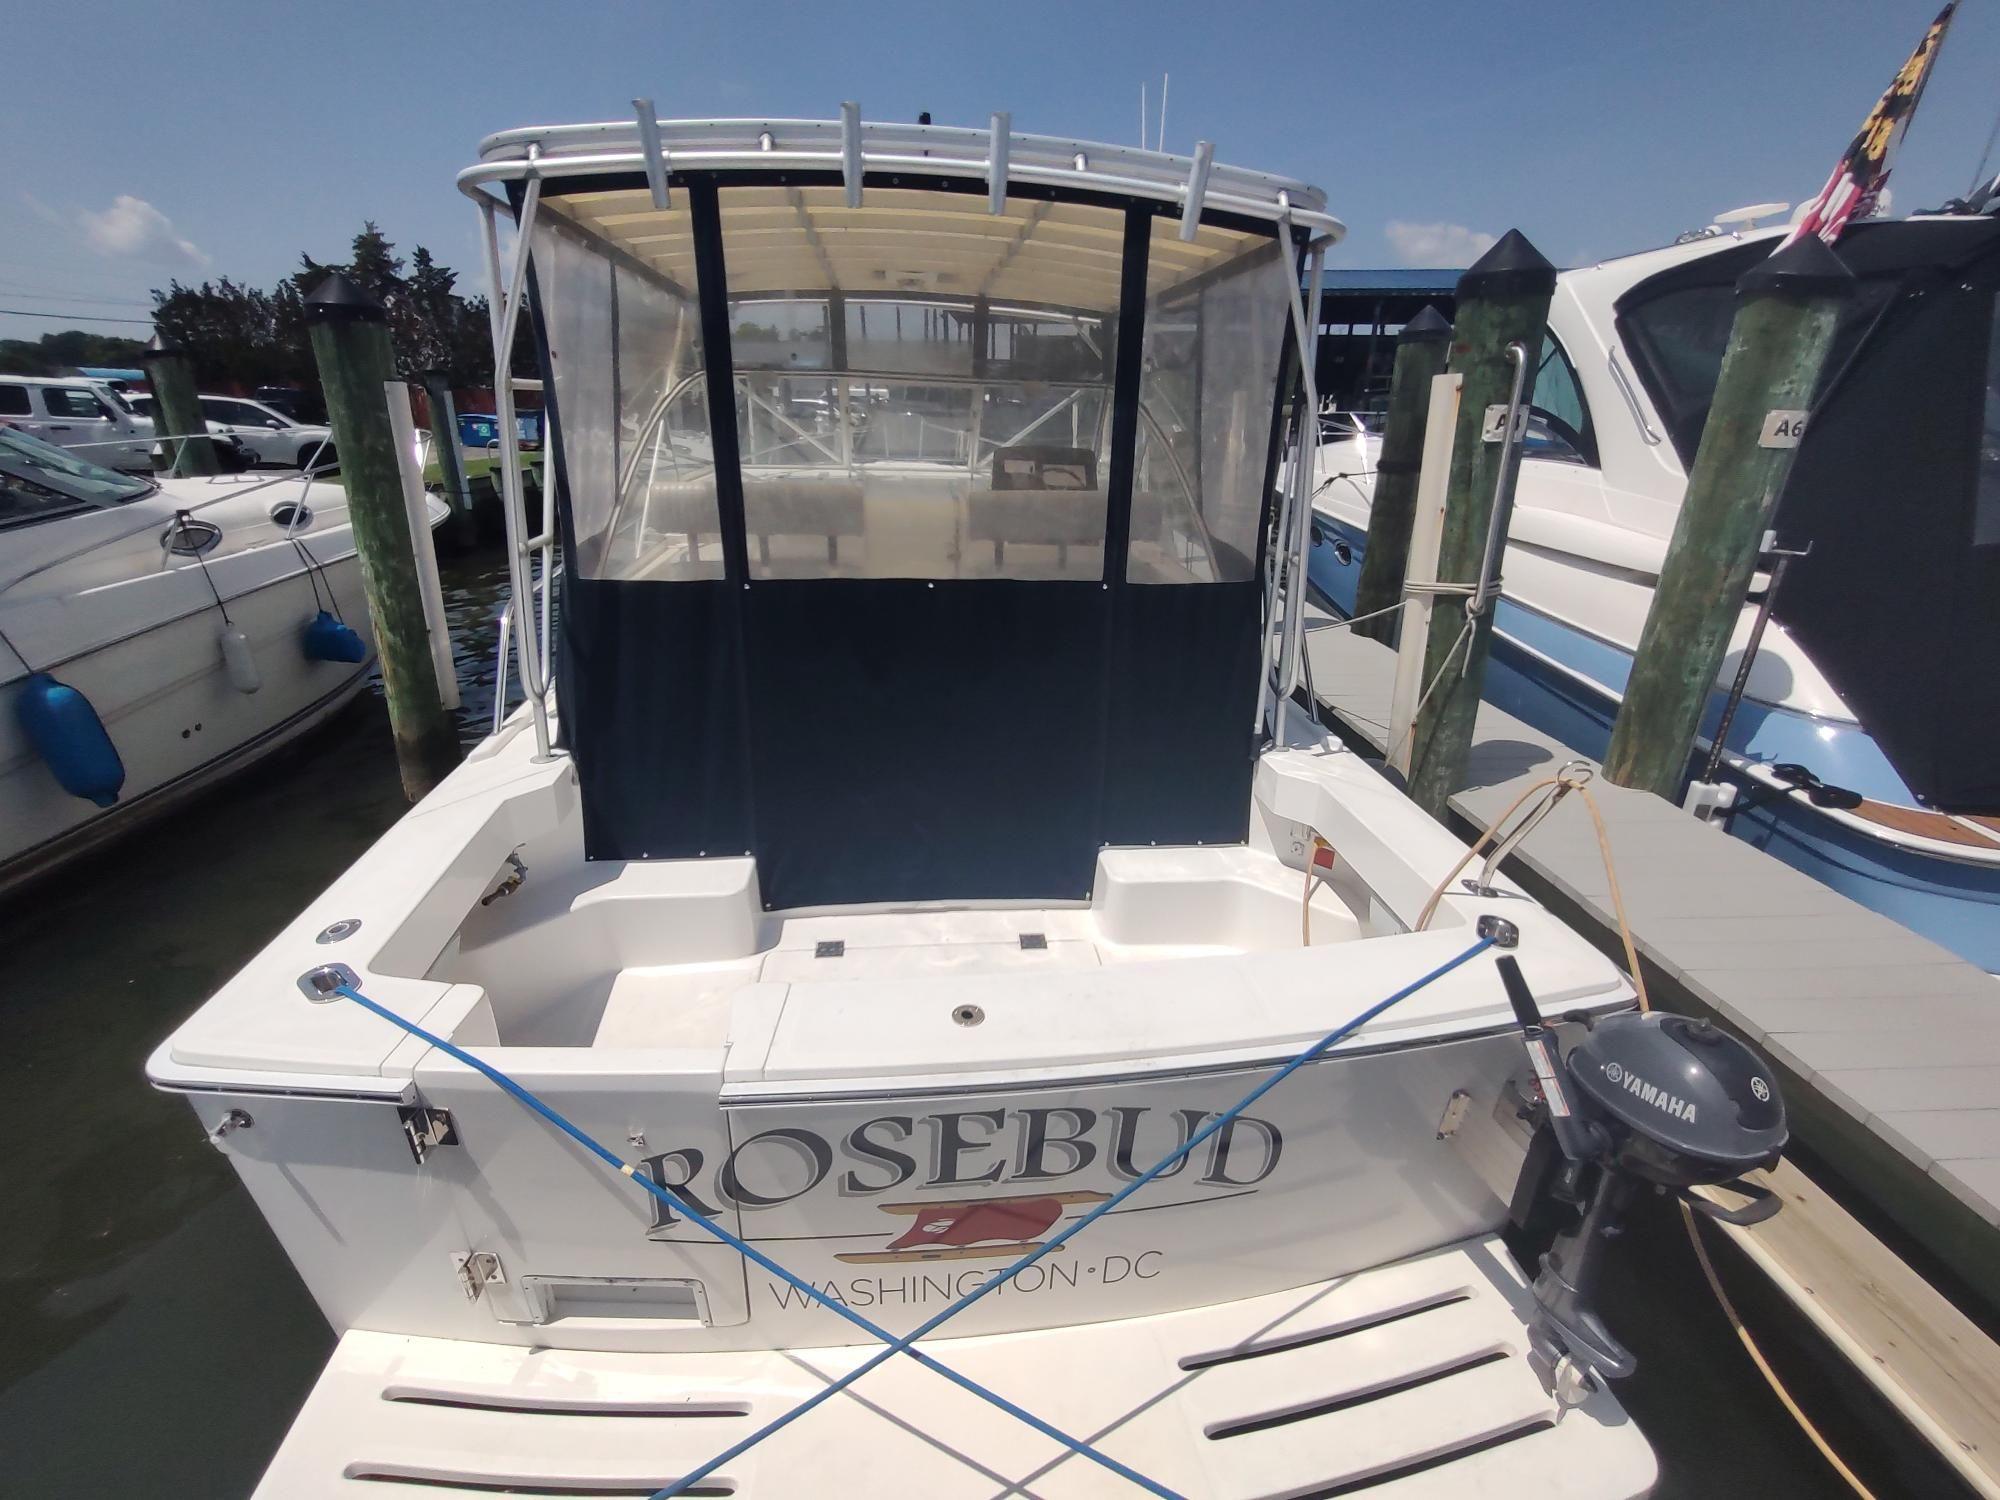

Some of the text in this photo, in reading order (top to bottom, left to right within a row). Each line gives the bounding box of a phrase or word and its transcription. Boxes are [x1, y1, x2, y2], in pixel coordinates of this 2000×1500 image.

[1773, 419, 1803, 437] A6
[1622, 1071, 1697, 1123] YAMAHA
[641, 1106, 1284, 1236] ROSEBUD
